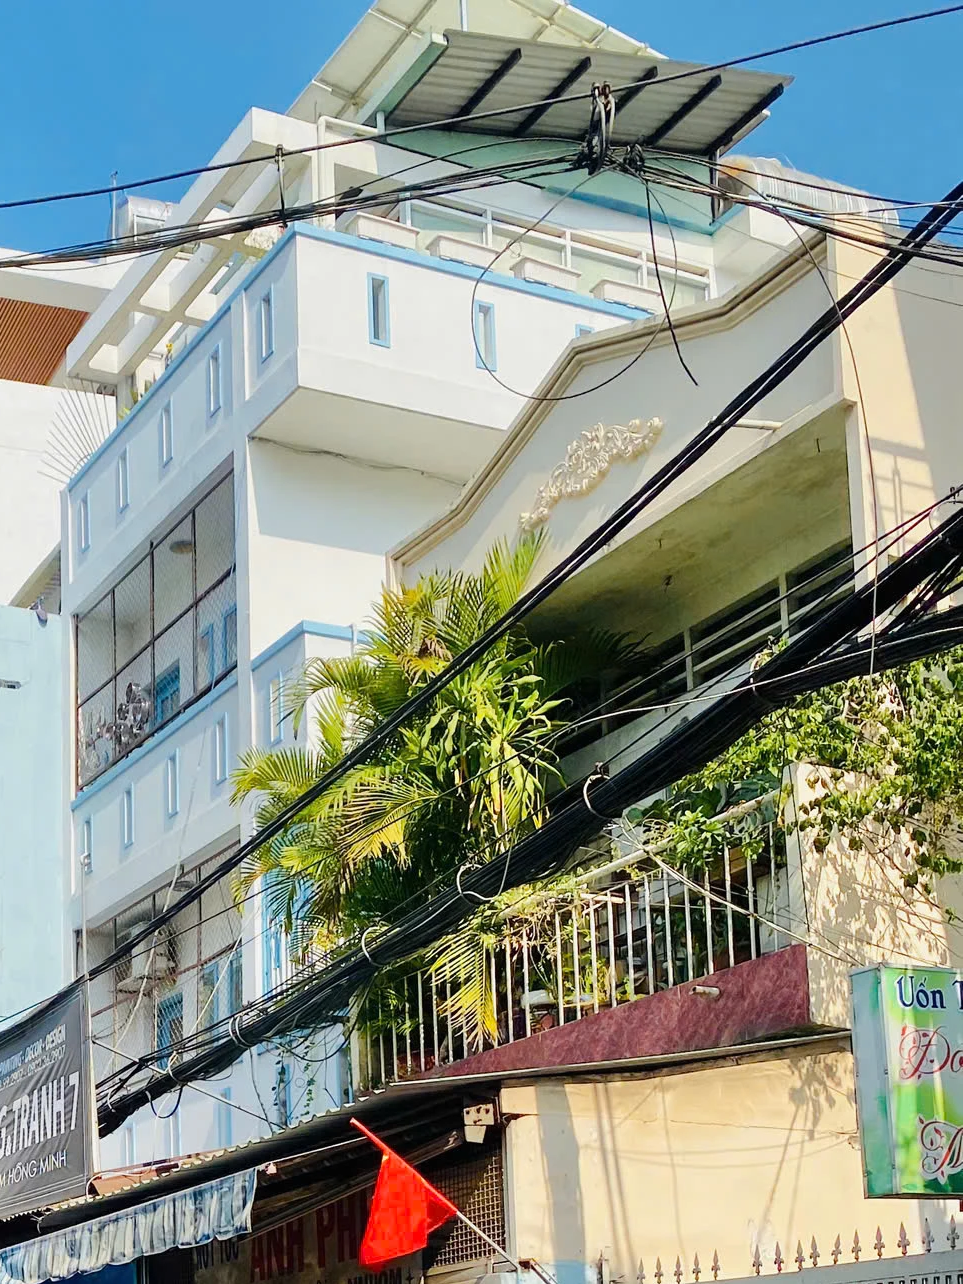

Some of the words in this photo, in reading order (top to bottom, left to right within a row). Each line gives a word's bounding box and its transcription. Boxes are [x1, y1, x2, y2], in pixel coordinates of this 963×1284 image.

[897, 975, 946, 1009] Uốn
[68, 1071, 80, 1131] 7
[39, 1149, 67, 1174] MINH
